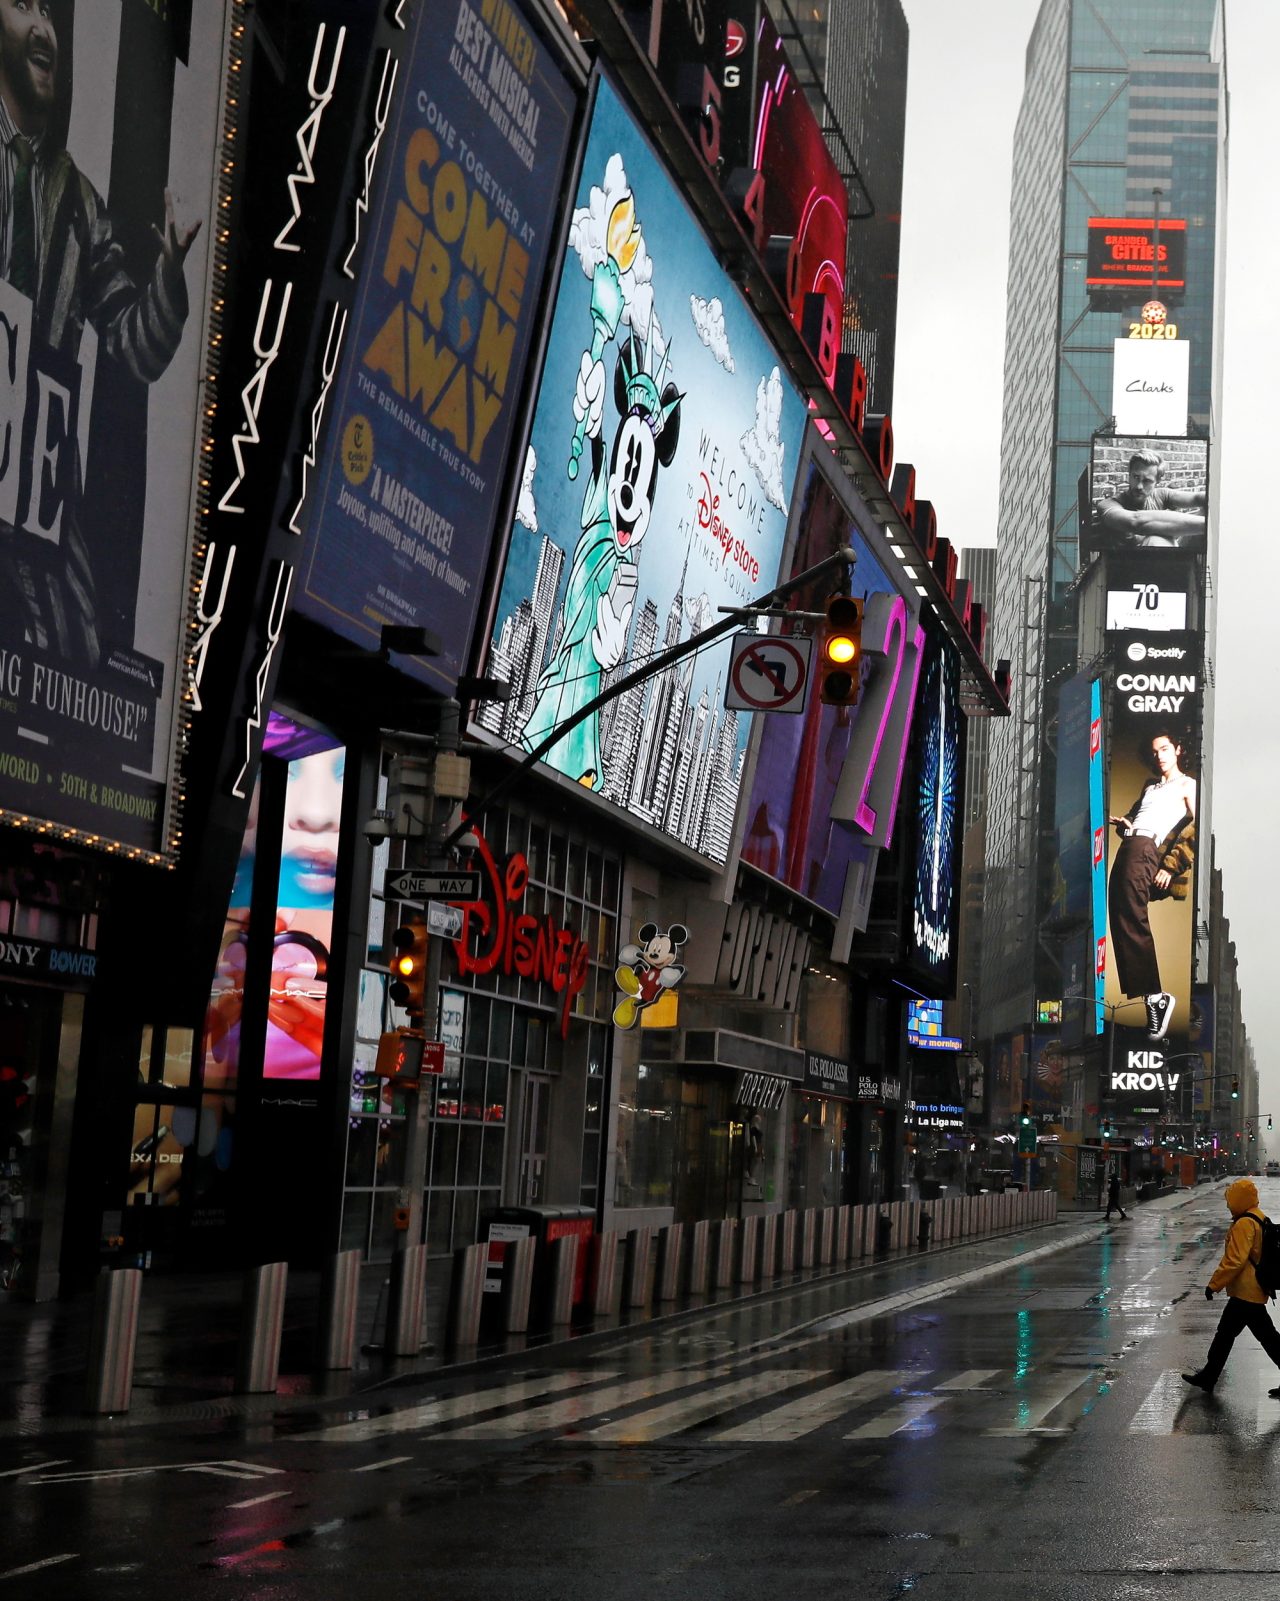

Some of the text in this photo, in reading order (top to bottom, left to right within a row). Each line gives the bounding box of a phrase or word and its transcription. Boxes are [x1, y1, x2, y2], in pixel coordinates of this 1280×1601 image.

[449, 44, 463, 76] ALL
[454, 0, 540, 148] BEST MUSICAL
[417, 90, 536, 248] COME TOGETHER AT
[404, 128, 530, 308] COME
[1105, 235, 1148, 246] BRANDED
[1112, 245, 1168, 261] CITIES
[1129, 323, 1178, 340] 2020
[361, 300, 502, 465] AWAY
[1125, 379, 1175, 394] Clarks
[358, 372, 486, 493] THE REMARKABLE TRUE STORY
[699, 428, 765, 535] WELCOME
[414, 539, 438, 577] plenty
[693, 532, 720, 573] TIMES
[733, 539, 759, 583] store
[1133, 584, 1159, 610] 70
[1148, 647, 1186, 660] Spotify
[1117, 674, 1196, 693] CONAN
[1127, 694, 1184, 713] GRAY
[60, 773, 88, 800] 50TH
[91, 784, 98, 804] &
[102, 786, 157, 821] BROADWAY
[400, 879, 467, 892] ONE WAY
[819, 1058, 833, 1079] POLO
[1127, 1051, 1164, 1069] KID
[736, 1072, 779, 1109] FOREVER
[1112, 1072, 1180, 1091] KROW
[918, 1117, 929, 1126] La
[931, 1117, 949, 1127] Liga
[1043, 1114, 1054, 1122] FX
